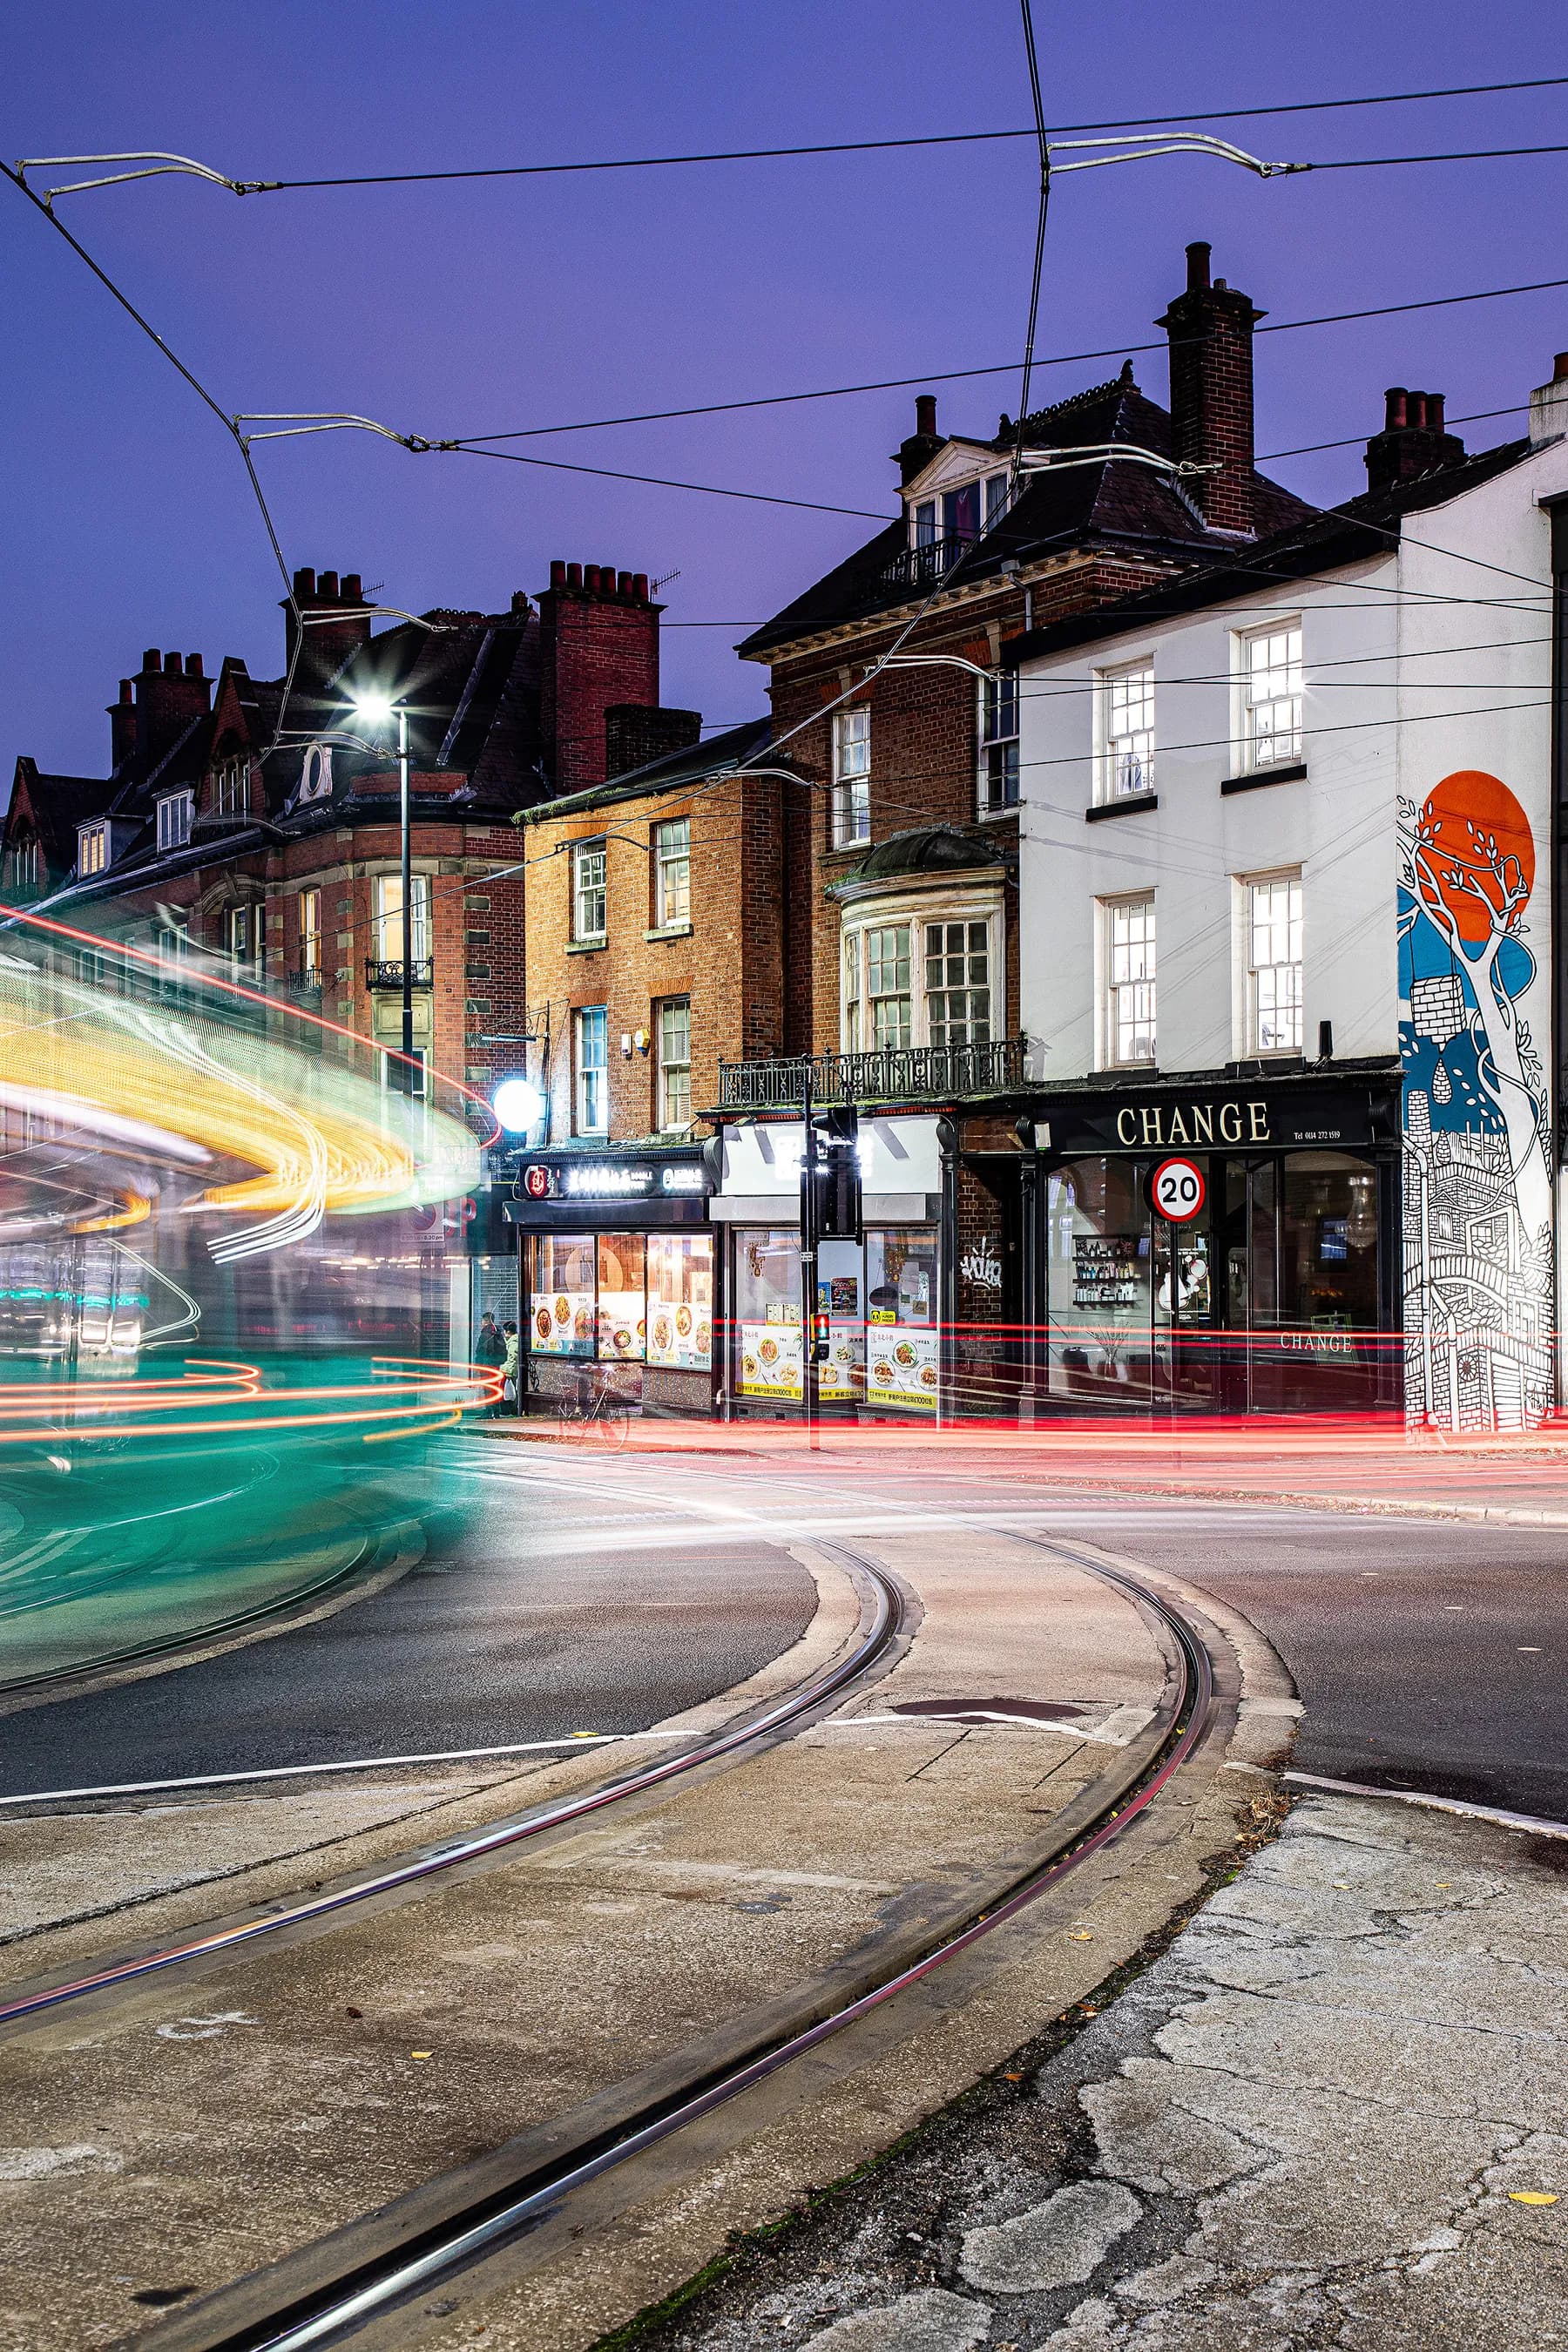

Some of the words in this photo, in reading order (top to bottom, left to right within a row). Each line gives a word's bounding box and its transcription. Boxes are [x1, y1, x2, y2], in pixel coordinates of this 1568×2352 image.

[1117, 1102, 1270, 1146] CHANGE
[1293, 1132, 1303, 1140] Tel
[1317, 1131, 1328, 1139] 272
[1161, 1176, 1198, 1203] 20
[1281, 1331, 1352, 1353] CHANGE
